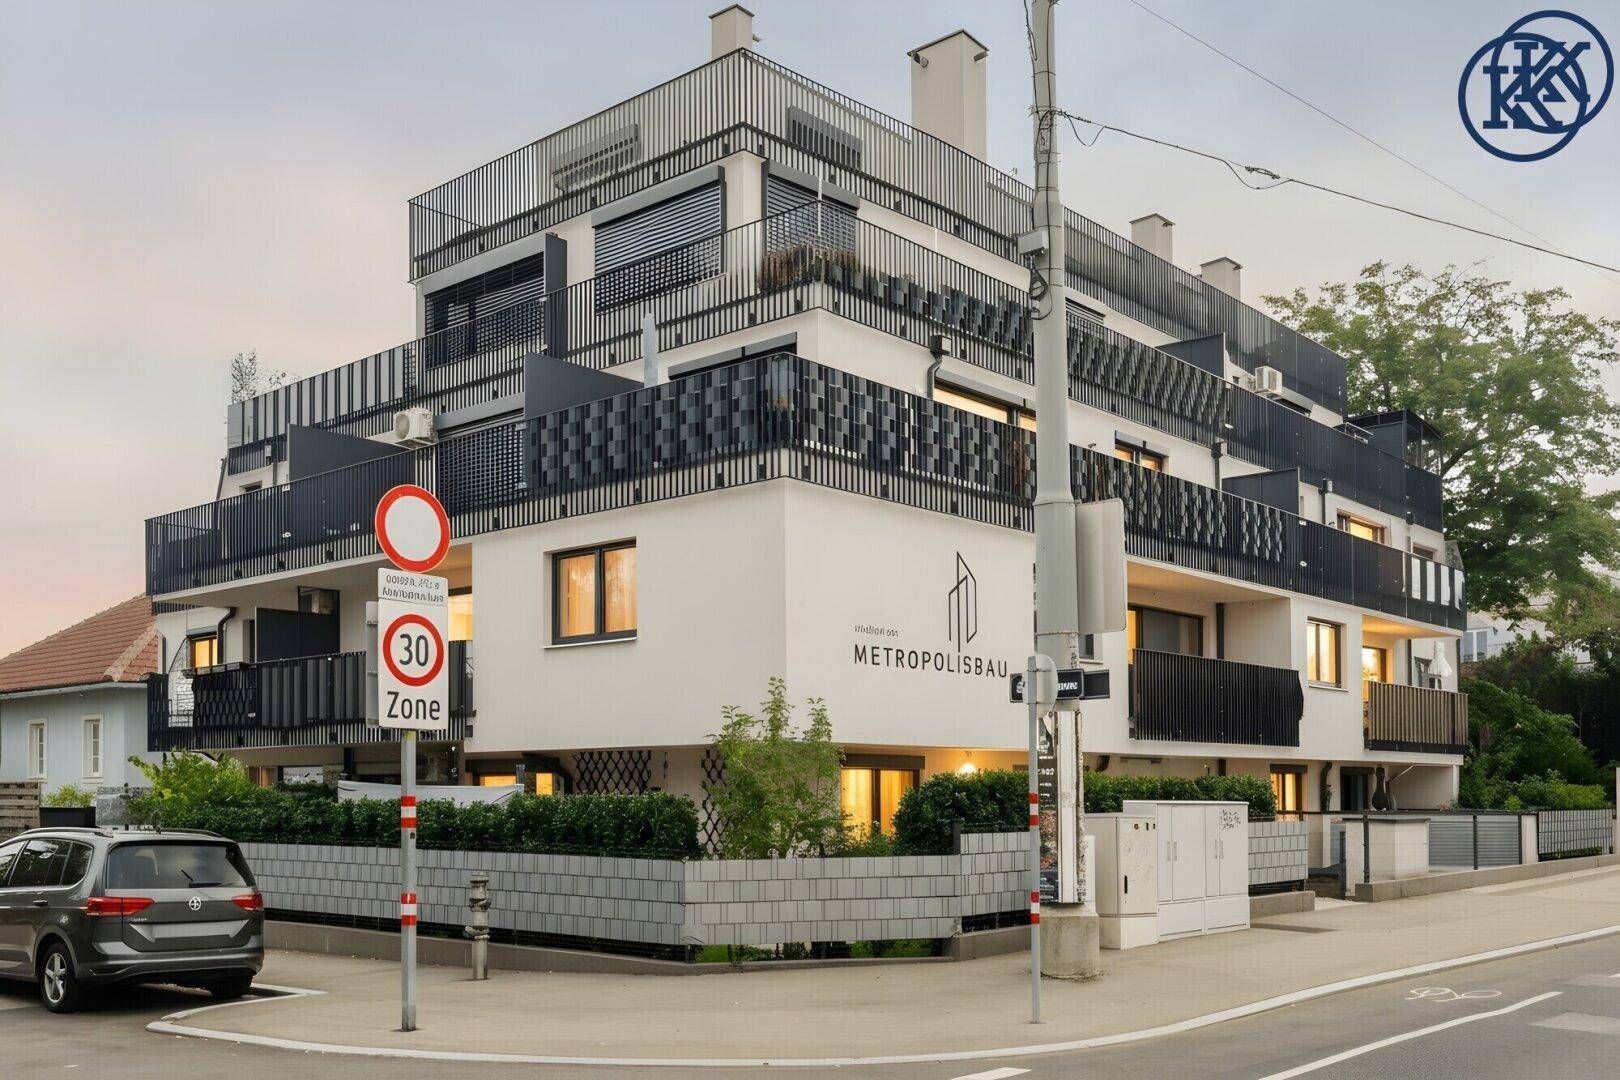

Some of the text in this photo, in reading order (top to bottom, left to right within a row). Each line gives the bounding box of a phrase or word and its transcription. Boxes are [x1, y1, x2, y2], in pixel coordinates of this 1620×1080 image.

[399, 633, 429, 667] 30
[854, 644, 1007, 678] METROPOLISBAU
[387, 690, 441, 721] Zone
